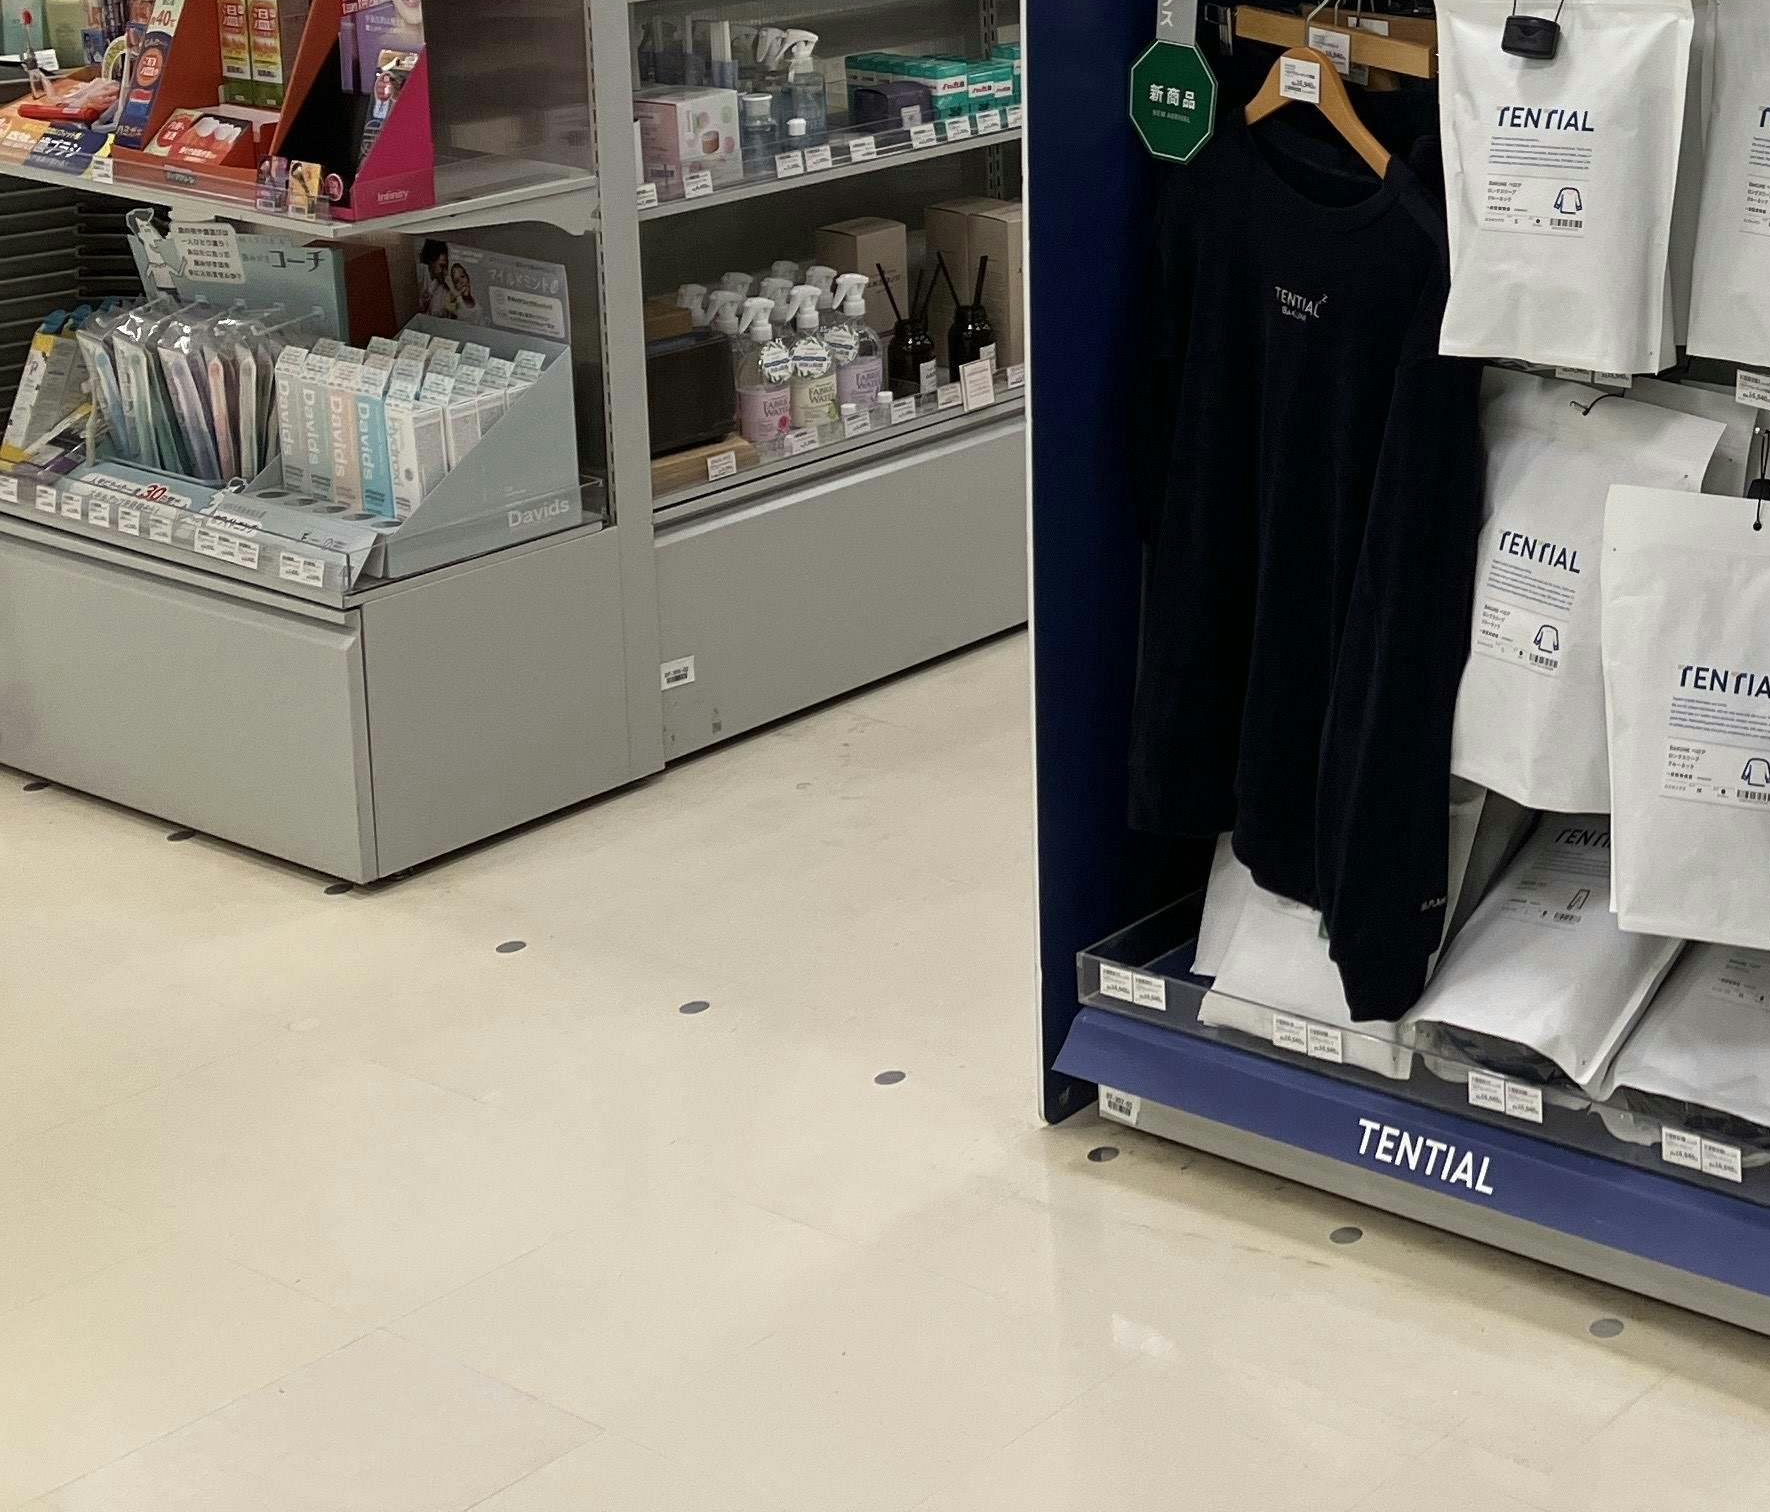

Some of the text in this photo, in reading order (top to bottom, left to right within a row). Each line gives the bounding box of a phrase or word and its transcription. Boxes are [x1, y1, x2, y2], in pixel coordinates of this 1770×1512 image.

[1149, 84, 1197, 111] 新商品
[1497, 106, 1594, 132] TENTIAL
[1274, 286, 1320, 319] TENTIAL
[507, 498, 570, 528] Davids
[1499, 528, 1581, 574] TENTIAL
[1357, 1118, 1495, 1197] TENTIAL
